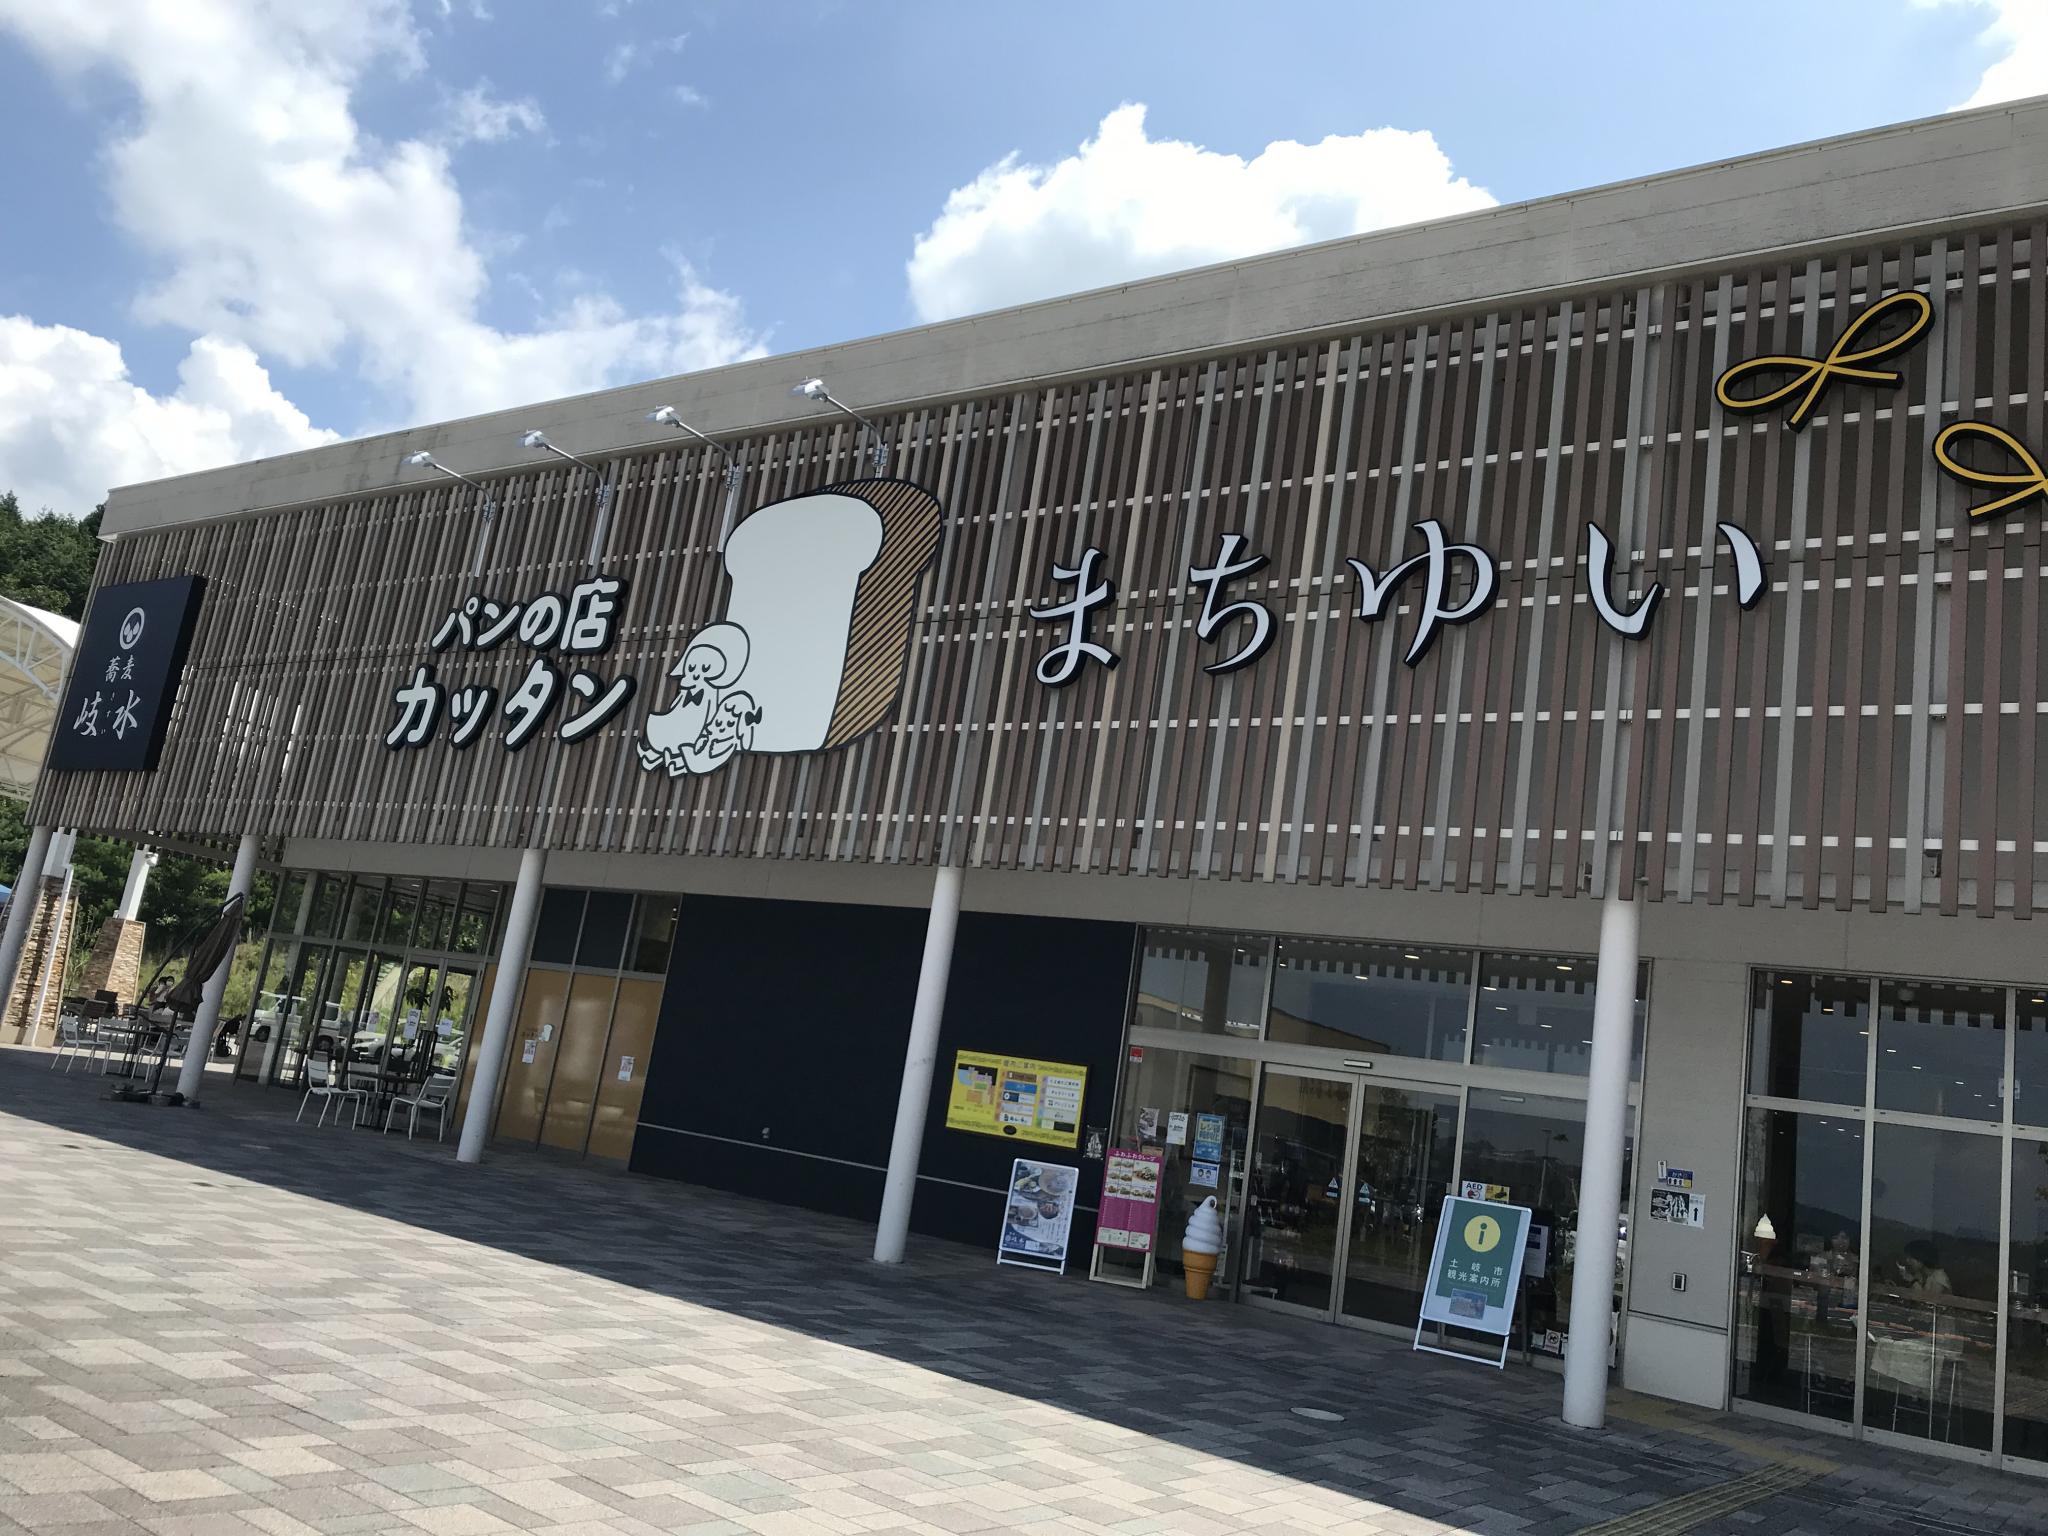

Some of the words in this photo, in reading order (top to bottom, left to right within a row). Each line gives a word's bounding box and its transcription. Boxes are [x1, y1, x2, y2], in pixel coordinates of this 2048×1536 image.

[430, 576, 621, 651] パンの店
[1029, 518, 1768, 686] まちゆい
[106, 654, 135, 683] 蕎麦
[73, 689, 141, 740] 岐水
[385, 657, 629, 746] カッタン
[1466, 1182, 1483, 1191] AED
[1447, 1268, 1501, 1288] 観光案内所
[1449, 1258, 1504, 1276] 土岐市
